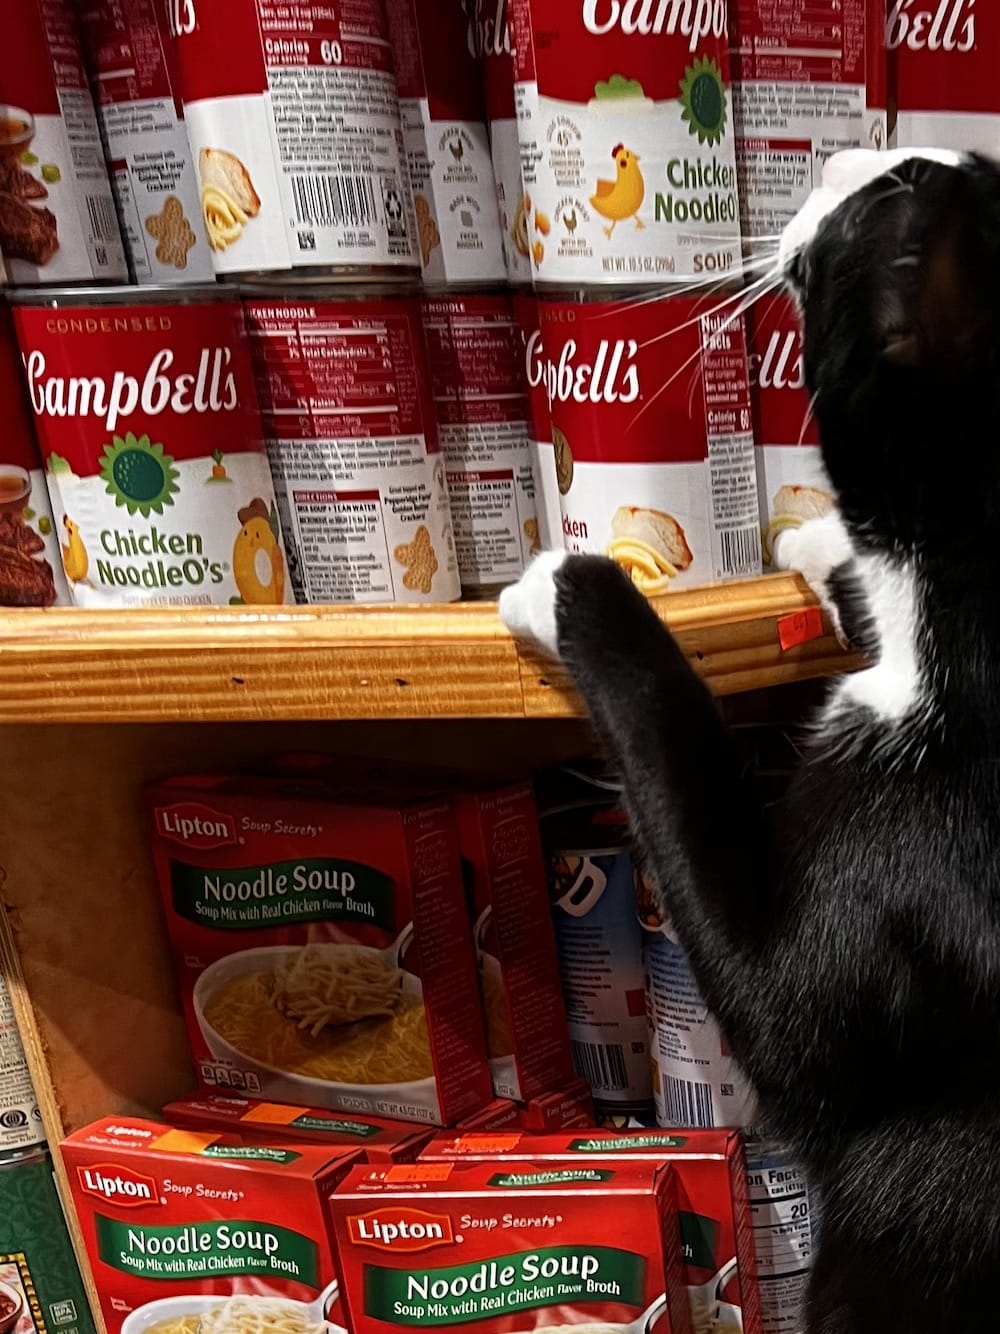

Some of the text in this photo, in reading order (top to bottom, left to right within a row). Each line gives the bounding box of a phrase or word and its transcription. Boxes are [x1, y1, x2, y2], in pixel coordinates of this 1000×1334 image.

[320, 40, 342, 64] 60
[666, 157, 734, 190] Chicken
[655, 192, 736, 223] NoodleO
[693, 253, 733, 273] SOUP
[46, 315, 172, 334] CONDENSED
[276, 307, 316, 319] NOODLE
[703, 334, 731, 350] Facts
[22, 346, 239, 431] Campbell's
[100, 525, 204, 557] Chicken
[99, 559, 224, 589] NoodleO's
[162, 812, 229, 839] Lipton
[241, 815, 317, 838] Soup Secrets
[203, 865, 356, 902] Noodle Soup
[194, 900, 219, 917] Soup
[220, 903, 237, 920] Mix
[239, 903, 260, 921] with
[261, 903, 281, 919] Real
[283, 898, 321, 917] Chicken
[346, 896, 375, 918] Broth
[83, 1170, 151, 1199] Lipton
[163, 1179, 238, 1202] Soup Secrets
[460, 1214, 555, 1230] Soup Secrets
[791, 1203, 807, 1219] 20
[128, 1225, 279, 1256] Noodle Soup
[357, 1218, 443, 1242] Lipton
[120, 1253, 145, 1272] Soup
[146, 1257, 163, 1274] Mix
[164, 1258, 185, 1273] with
[187, 1256, 206, 1272] Real
[208, 1255, 245, 1270] Chicken
[270, 1254, 299, 1275] Broth
[408, 1253, 600, 1301] Noodle Soup
[394, 1277, 621, 1318] Soup Mix with Real Chicken Flavor Broth
